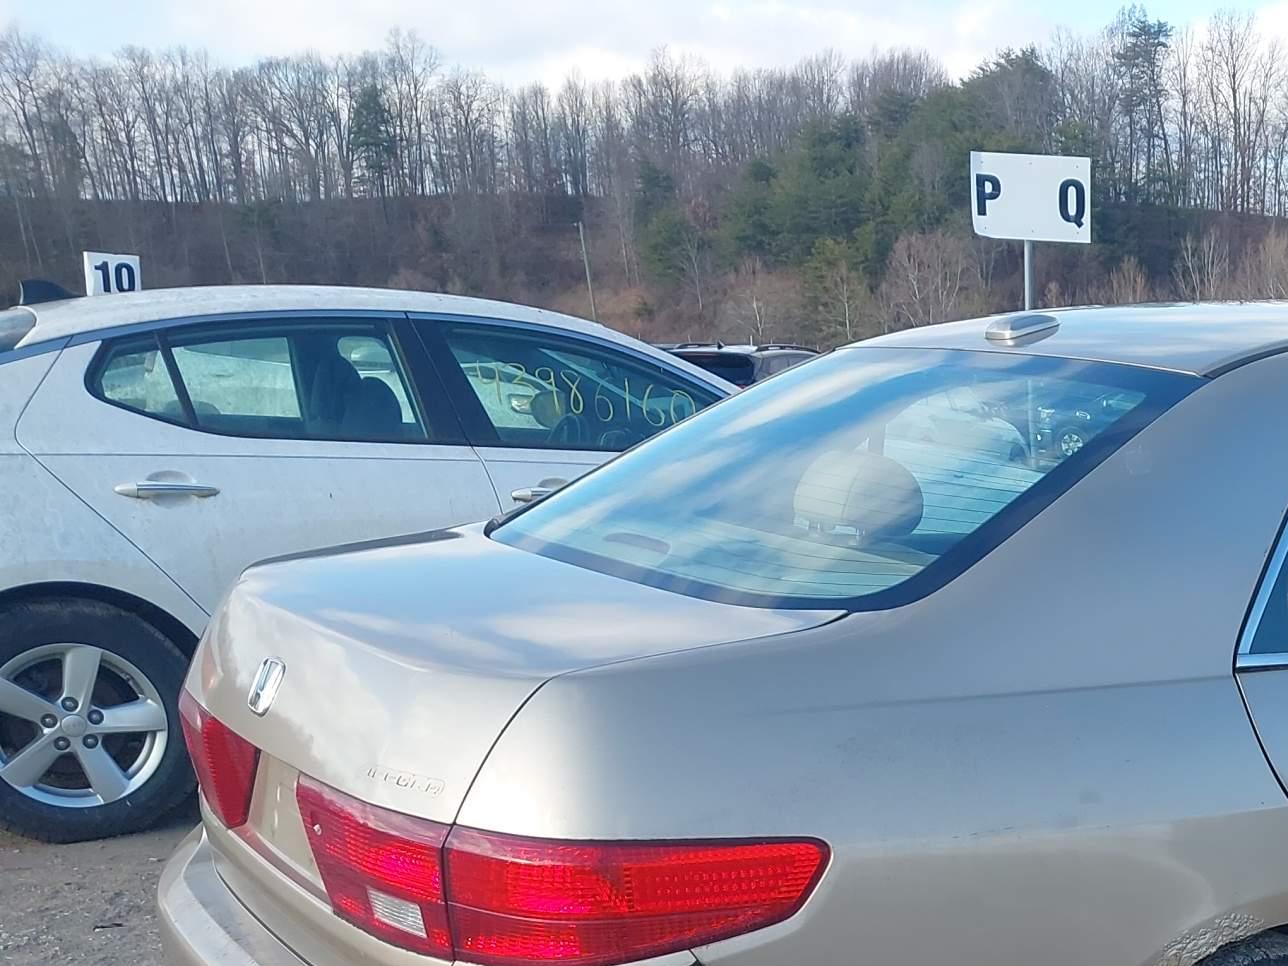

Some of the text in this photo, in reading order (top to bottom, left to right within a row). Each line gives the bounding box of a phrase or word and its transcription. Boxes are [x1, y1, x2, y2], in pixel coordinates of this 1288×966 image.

[975, 173, 1085, 229] P Q
[94, 260, 136, 294] 10
